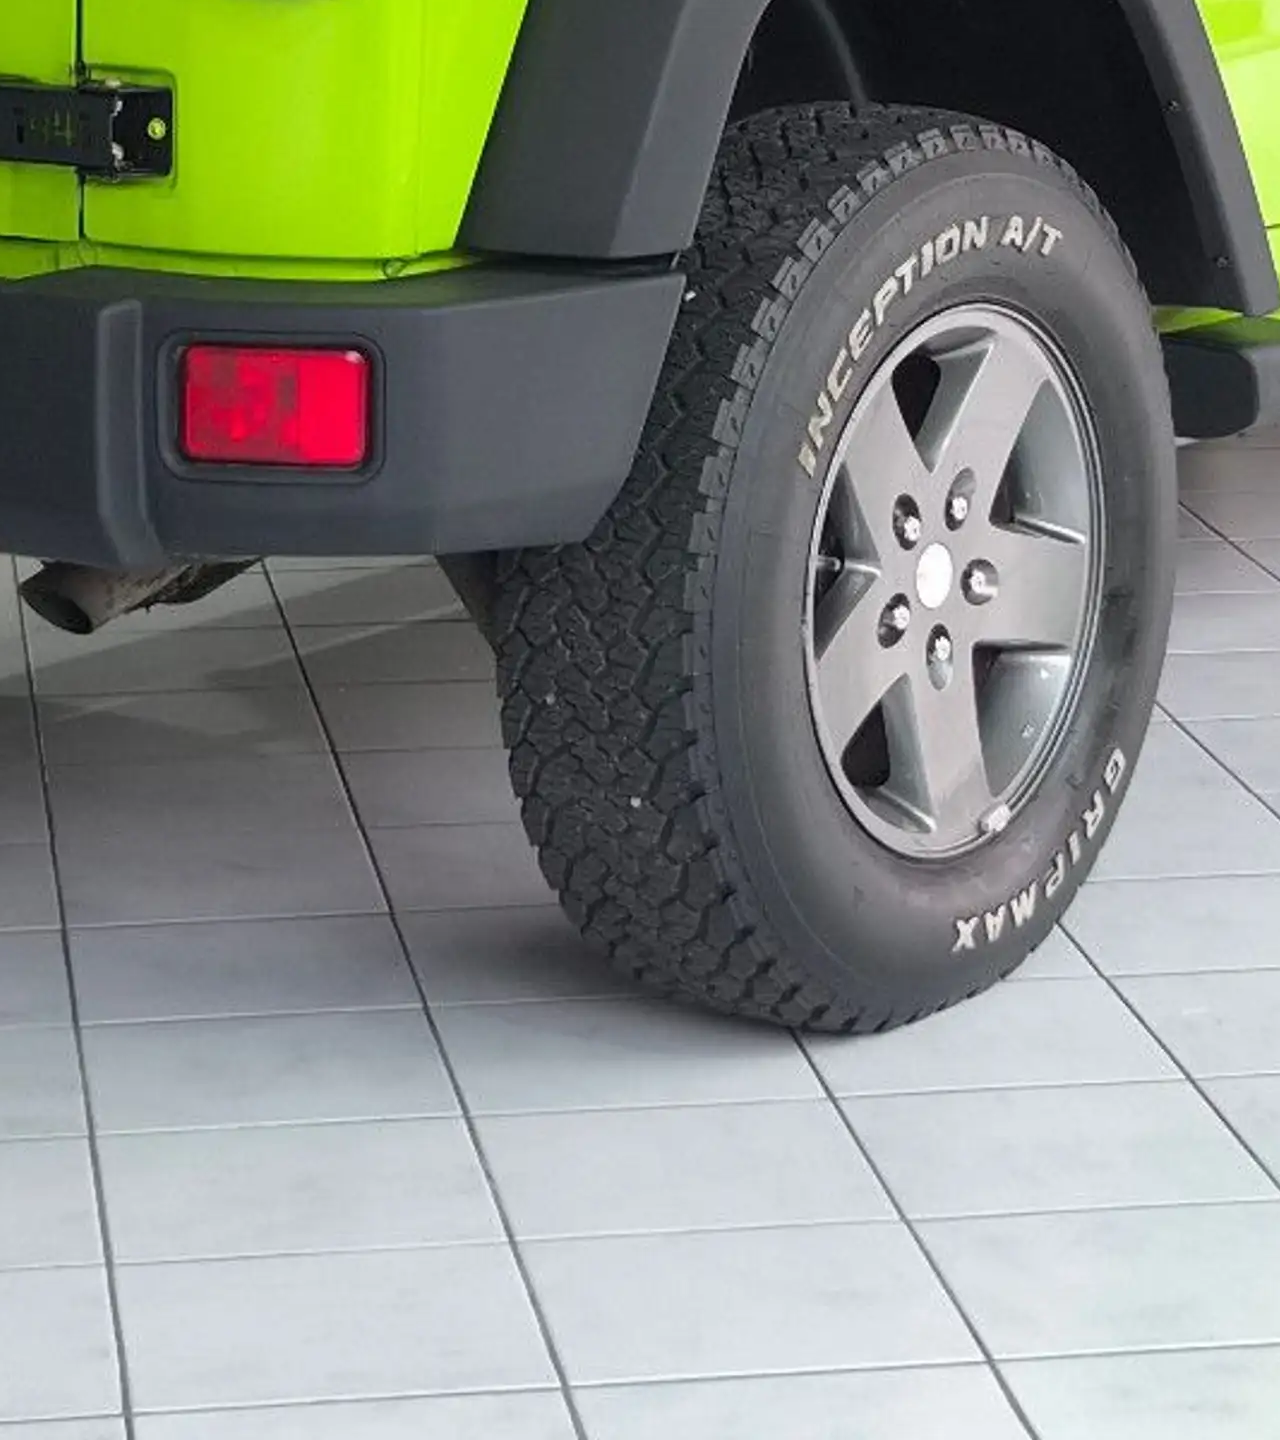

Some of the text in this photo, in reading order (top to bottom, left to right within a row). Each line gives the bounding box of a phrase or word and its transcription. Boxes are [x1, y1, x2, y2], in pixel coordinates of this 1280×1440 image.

[796, 214, 1065, 479] INCEPTION A/T
[952, 748, 1128, 954] GRIPMAX
